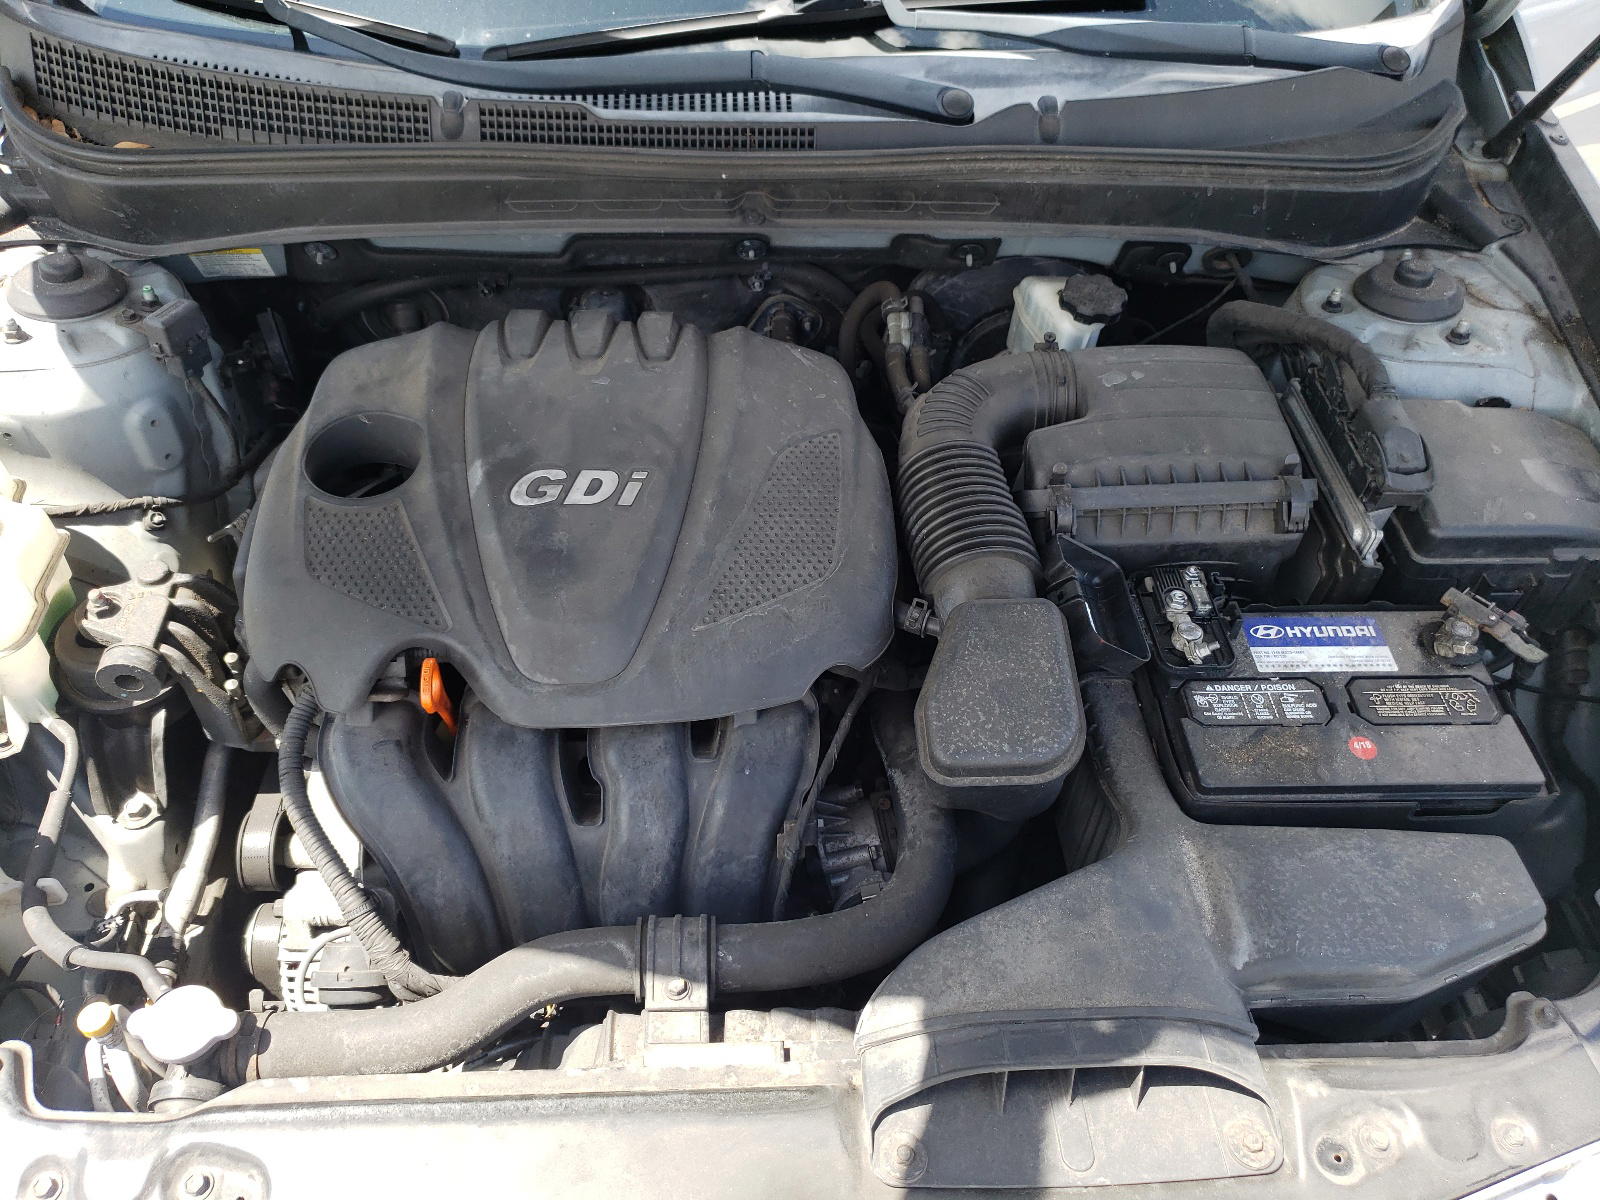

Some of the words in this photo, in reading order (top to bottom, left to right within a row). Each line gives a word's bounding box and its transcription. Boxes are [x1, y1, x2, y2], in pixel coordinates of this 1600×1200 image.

[509, 468, 649, 507] GDi
[1285, 625, 1377, 638] HYUNDAI
[1214, 684, 1252, 692] DANGER
[1260, 683, 1296, 691] POISON
